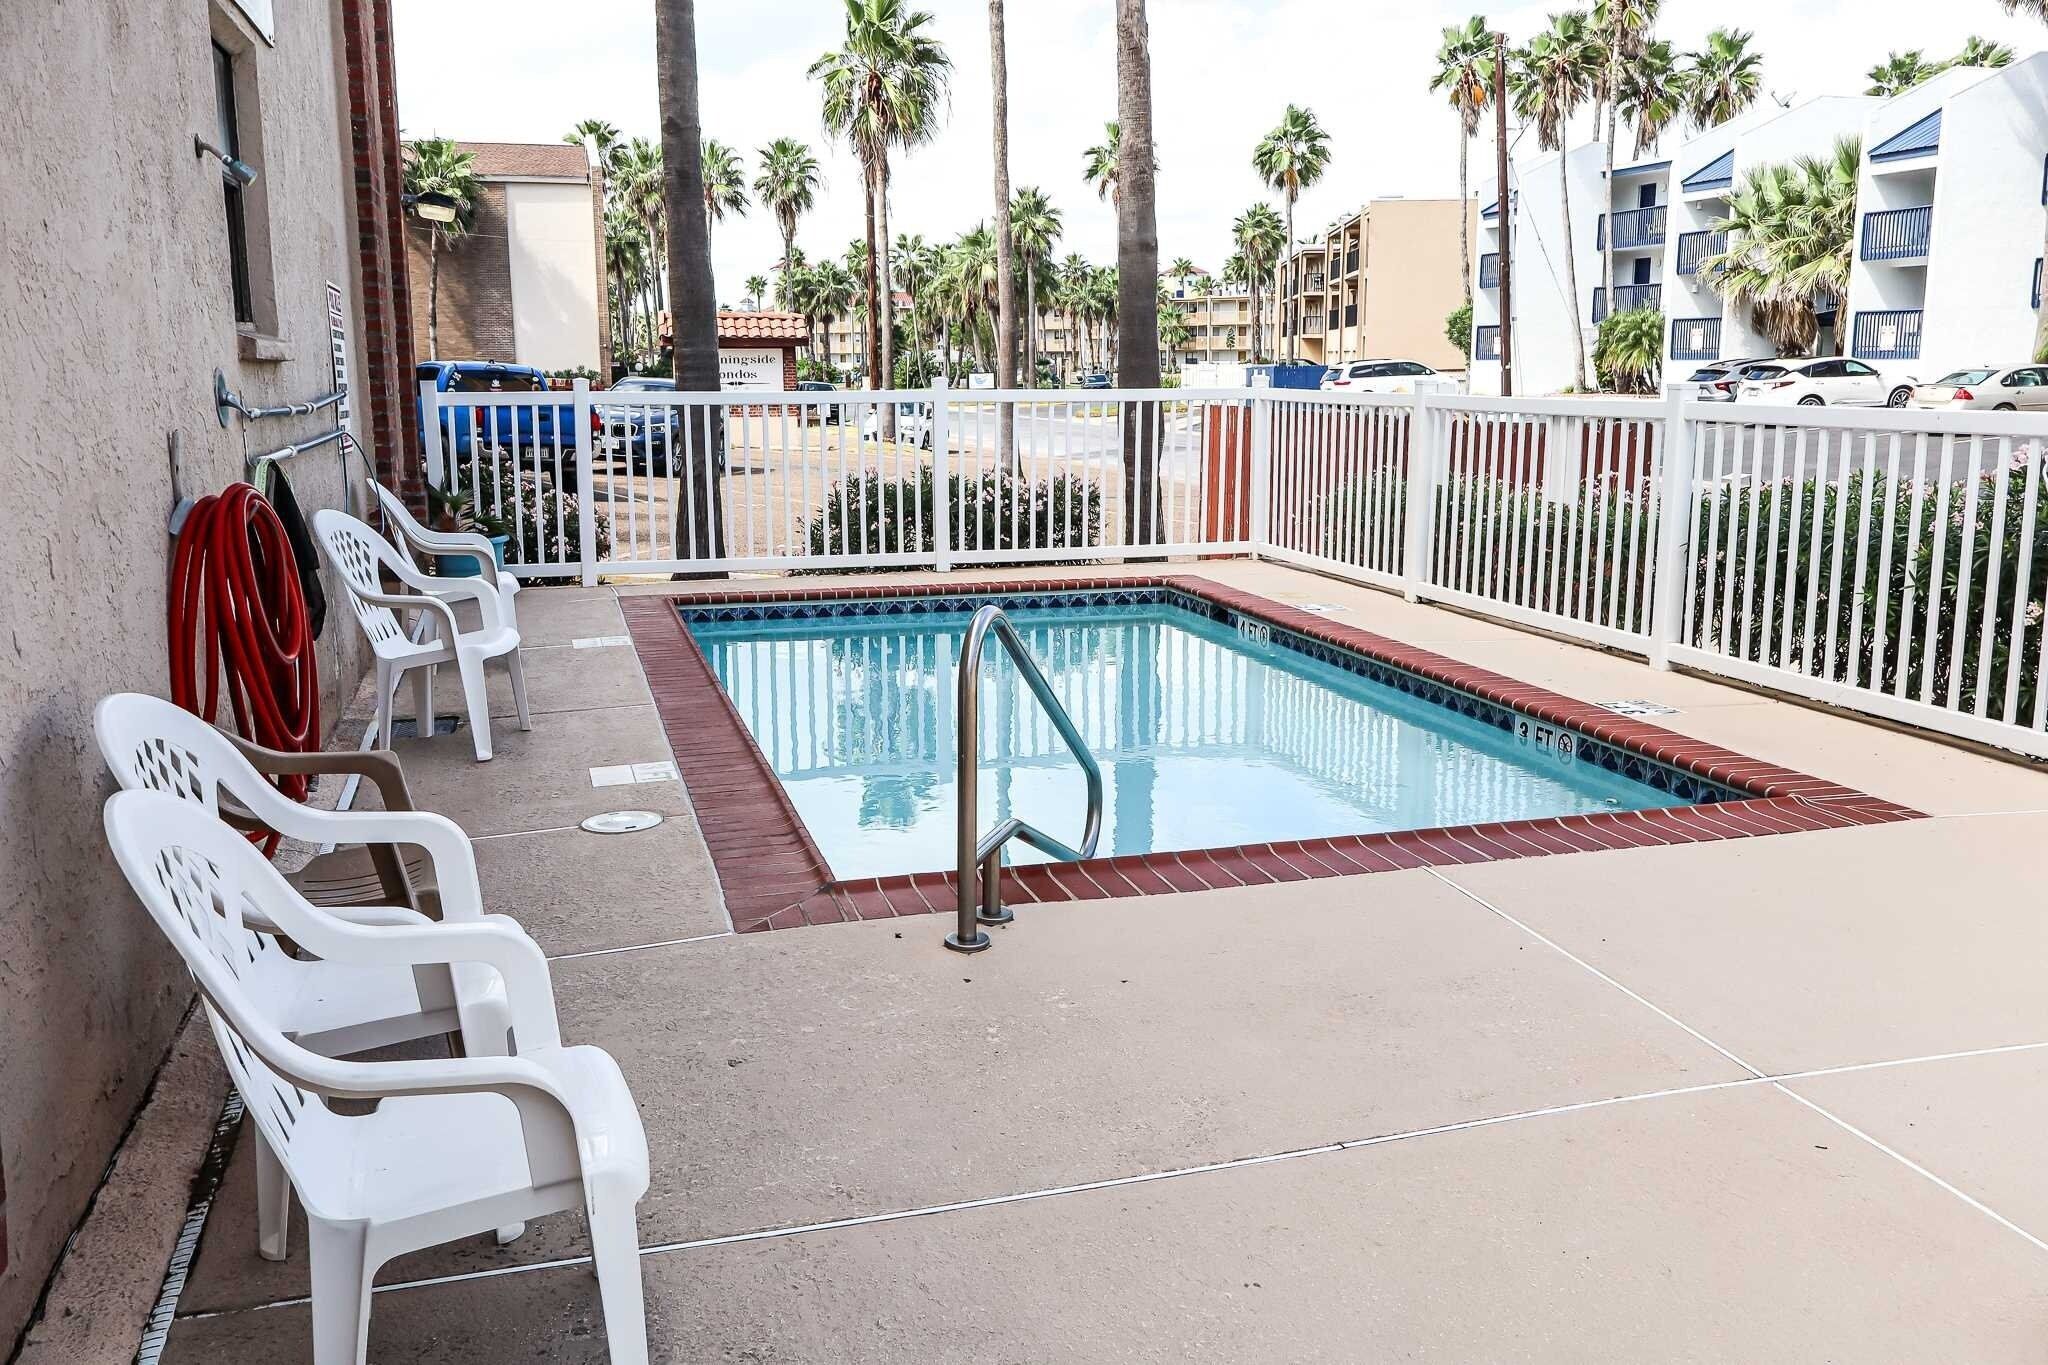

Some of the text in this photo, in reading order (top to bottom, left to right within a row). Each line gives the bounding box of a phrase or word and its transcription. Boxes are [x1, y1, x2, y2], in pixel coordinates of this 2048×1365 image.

[720, 355, 776, 366] ningside
[720, 369, 758, 379] ondos
[1519, 721, 1554, 747] 3 FT
